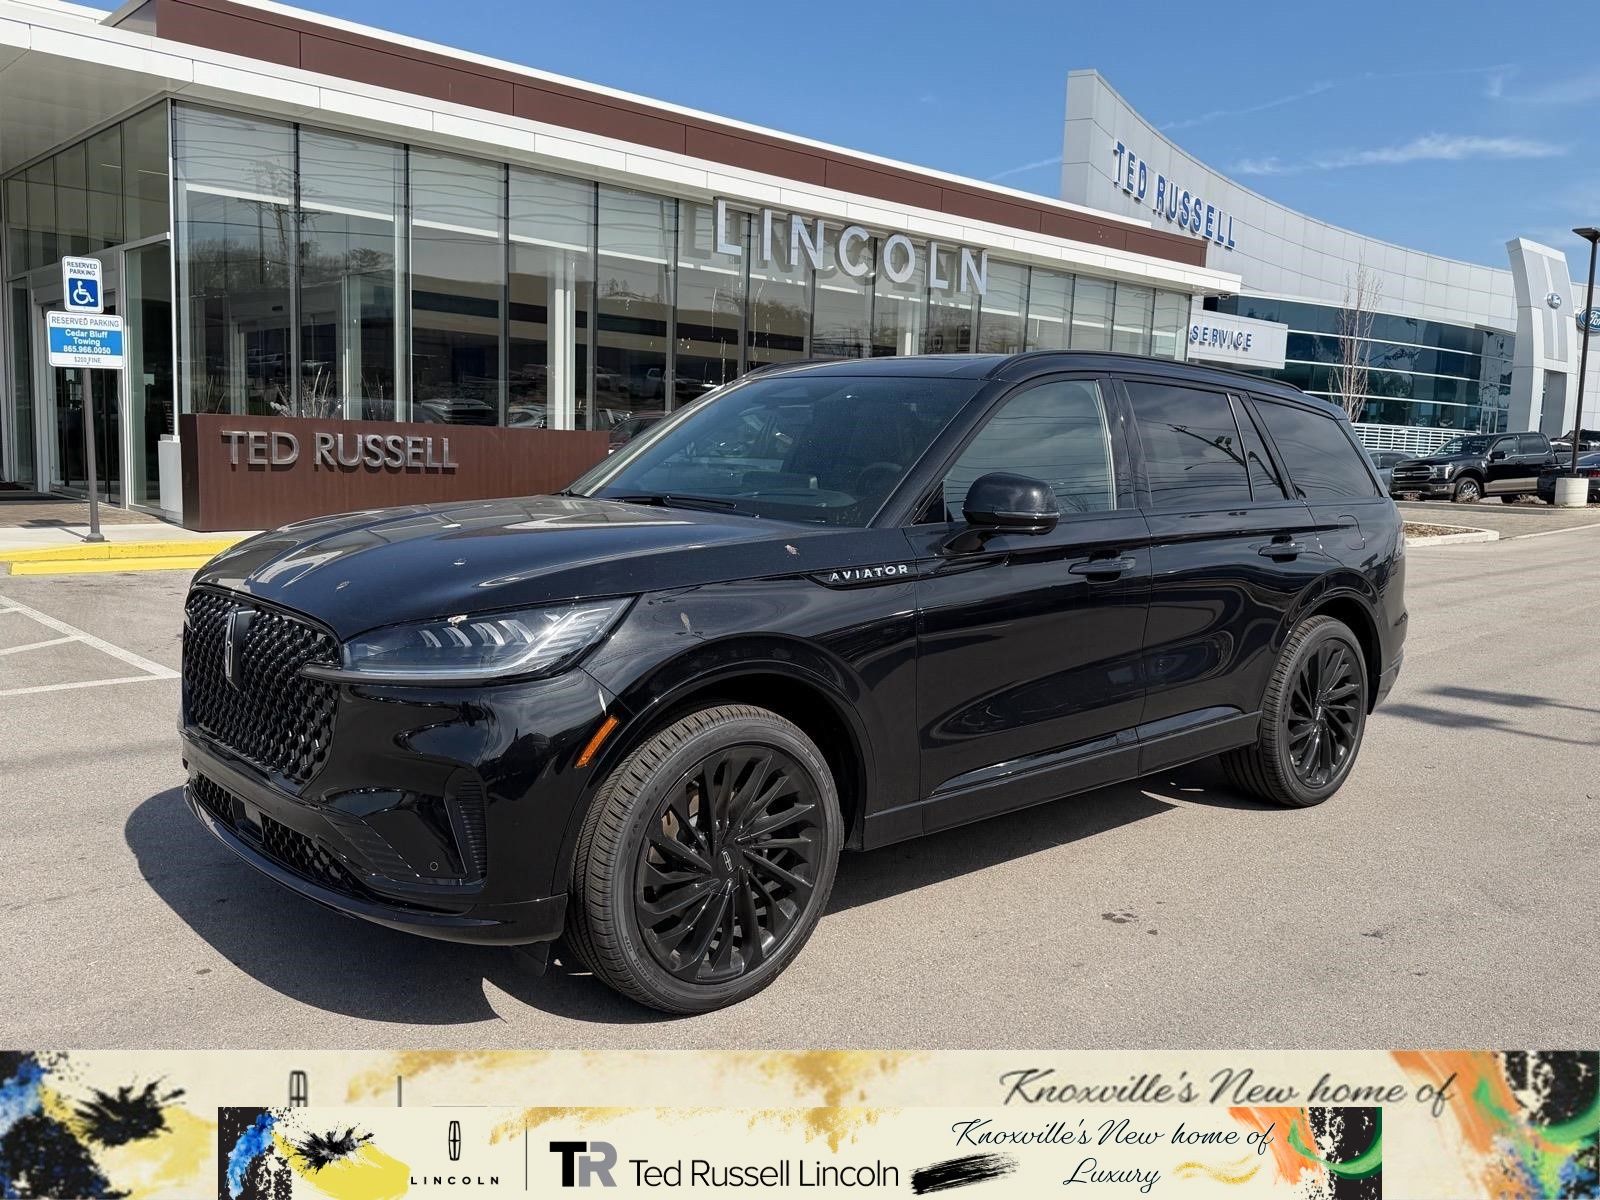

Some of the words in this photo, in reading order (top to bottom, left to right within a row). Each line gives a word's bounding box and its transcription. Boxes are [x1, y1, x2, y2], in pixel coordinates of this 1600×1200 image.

[1113, 139, 1147, 200] TED
[1155, 172, 1236, 249] RUSSELL
[714, 197, 988, 295] LINCOLN
[66, 261, 98, 270] RESERVED
[69, 268, 96, 276] PARKING
[51, 316, 88, 326] RESERVED
[89, 319, 120, 328] PARKING
[65, 329, 88, 337] Cedar
[89, 330, 109, 339] Bluff
[1190, 324, 1252, 348] SERVICE
[72, 337, 101, 346] Towing
[63, 345, 111, 354] 865.966.0050
[222, 430, 299, 466] TED
[314, 432, 459, 469] RUSSELL
[830, 564, 909, 582] AVIATOR
